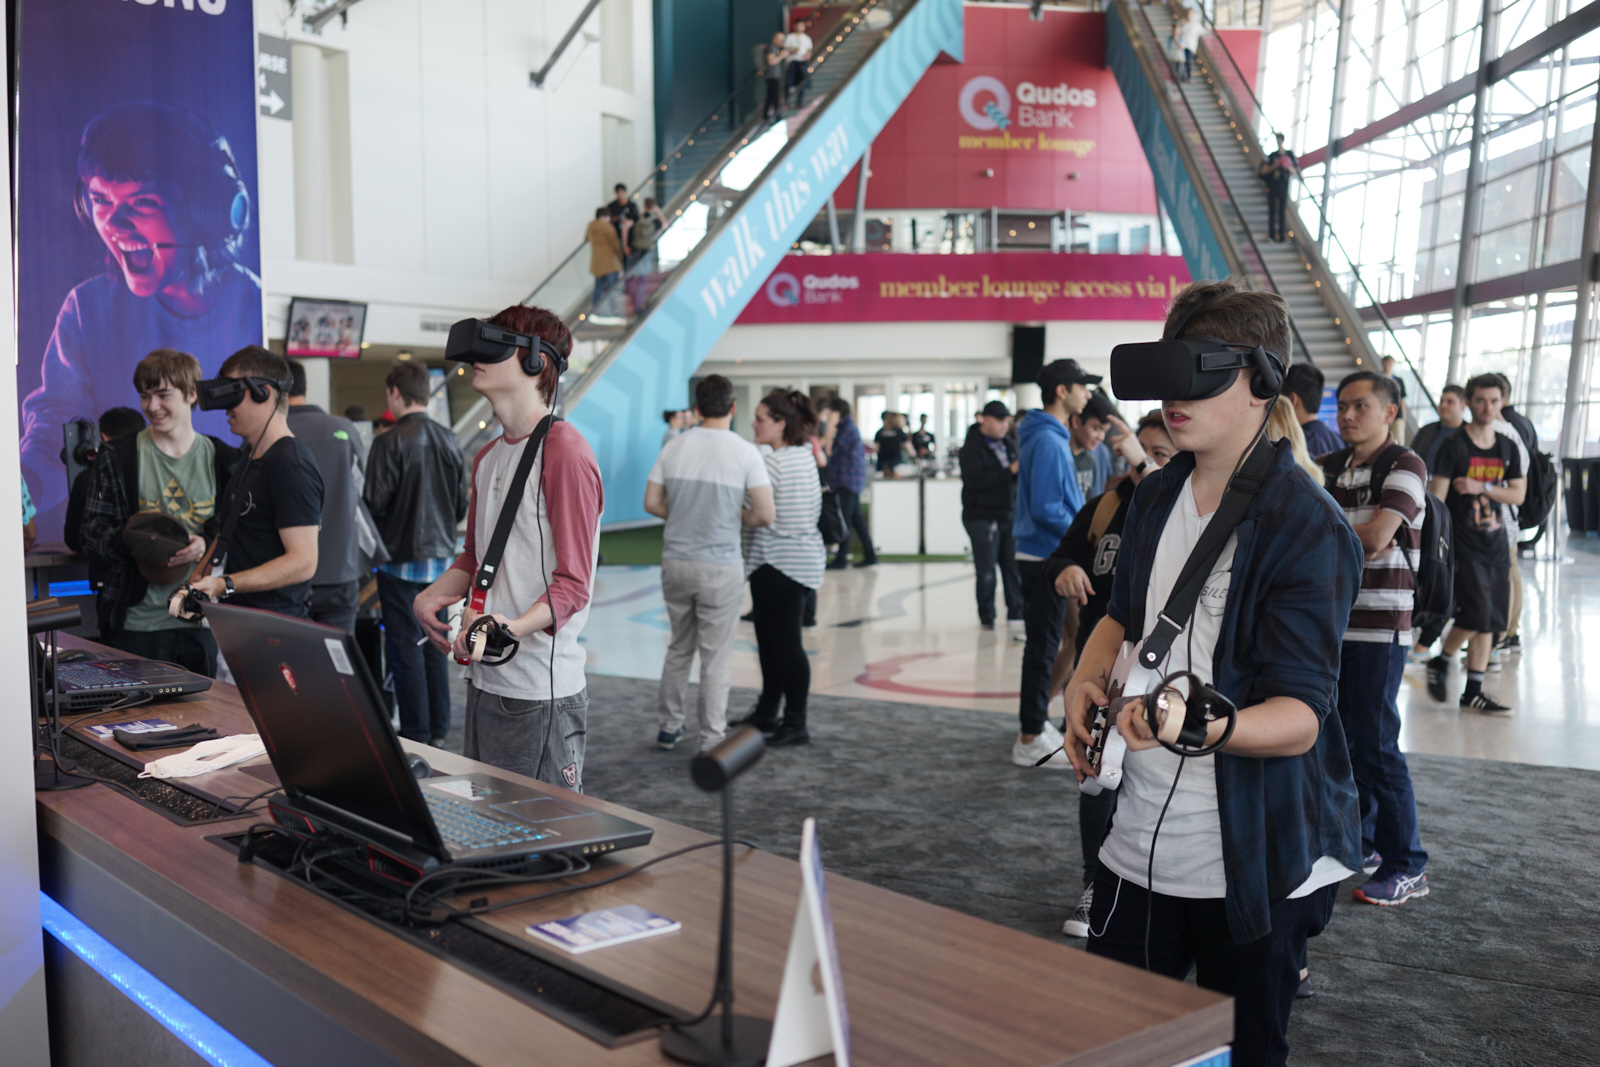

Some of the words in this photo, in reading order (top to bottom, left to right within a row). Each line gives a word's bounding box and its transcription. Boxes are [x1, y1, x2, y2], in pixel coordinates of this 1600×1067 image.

[1016, 82, 1096, 107] Qudos
[1018, 105, 1074, 129] Bank
[958, 131, 1035, 150] member
[1038, 132, 1096, 158] lounge
[700, 214, 767, 320] walk
[764, 162, 812, 242] this
[810, 116, 850, 185] way
[803, 274, 860, 290] Qudos
[880, 274, 979, 298] member
[982, 274, 1061, 304] lounge
[1063, 280, 1134, 298] access
[1135, 274, 1166, 298] via
[804, 289, 845, 304] Bank
[1201, 585, 1229, 599] SILE
